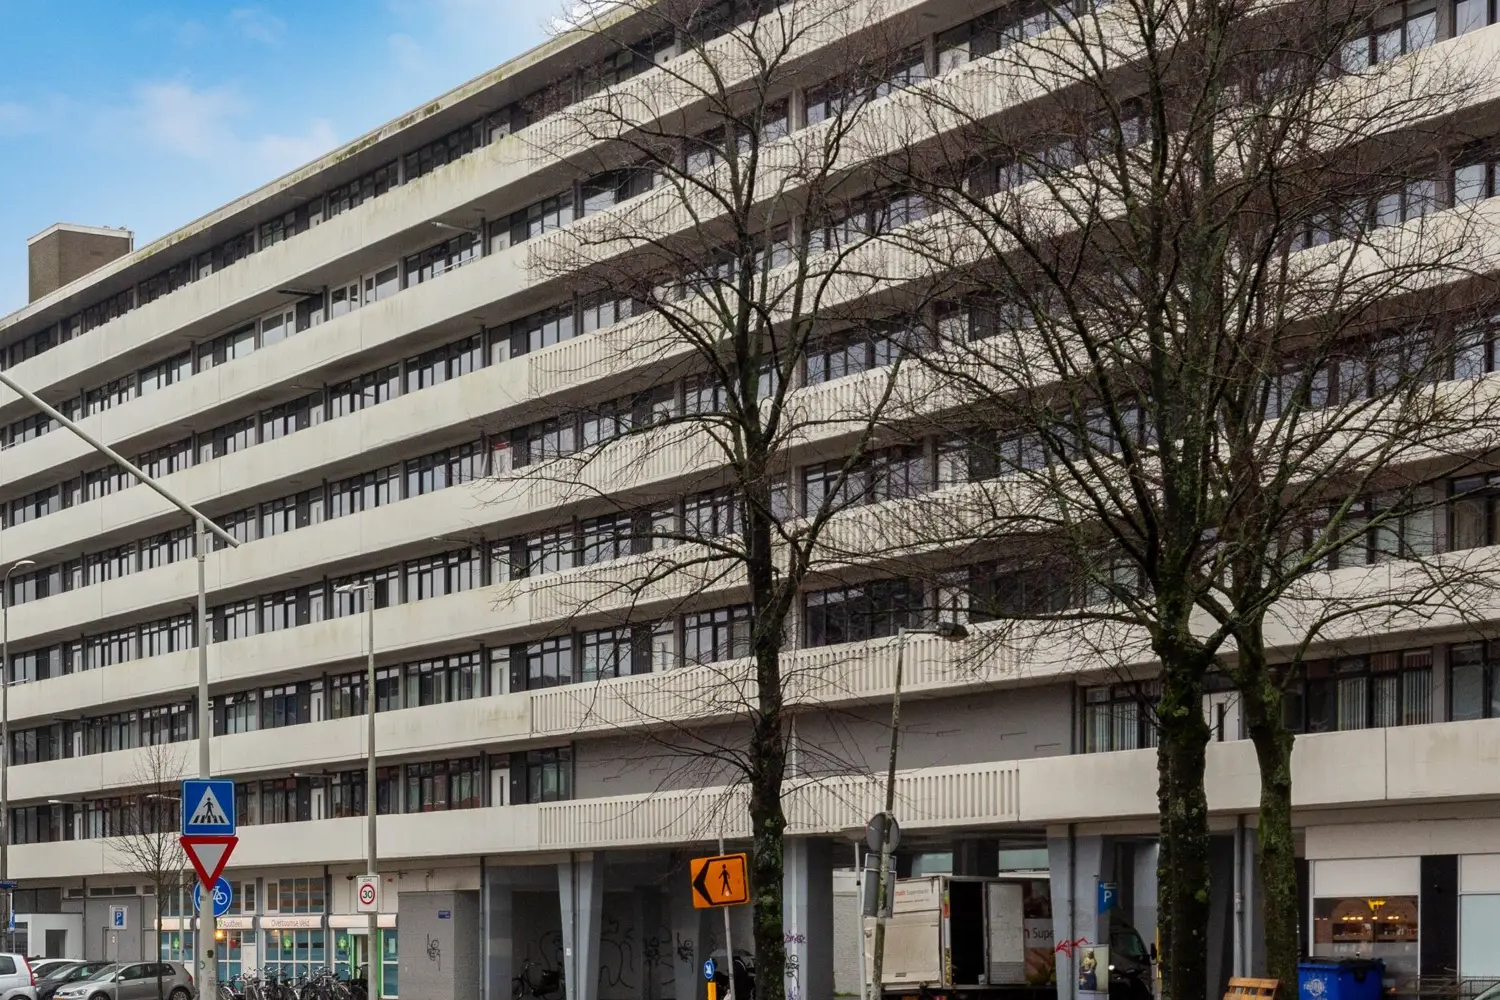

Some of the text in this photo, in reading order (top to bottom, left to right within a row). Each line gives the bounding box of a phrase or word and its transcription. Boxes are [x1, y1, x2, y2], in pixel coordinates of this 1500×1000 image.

[362, 890, 373, 899] 30
[1103, 890, 1113, 903] P
[300, 919, 310, 927] Veld
